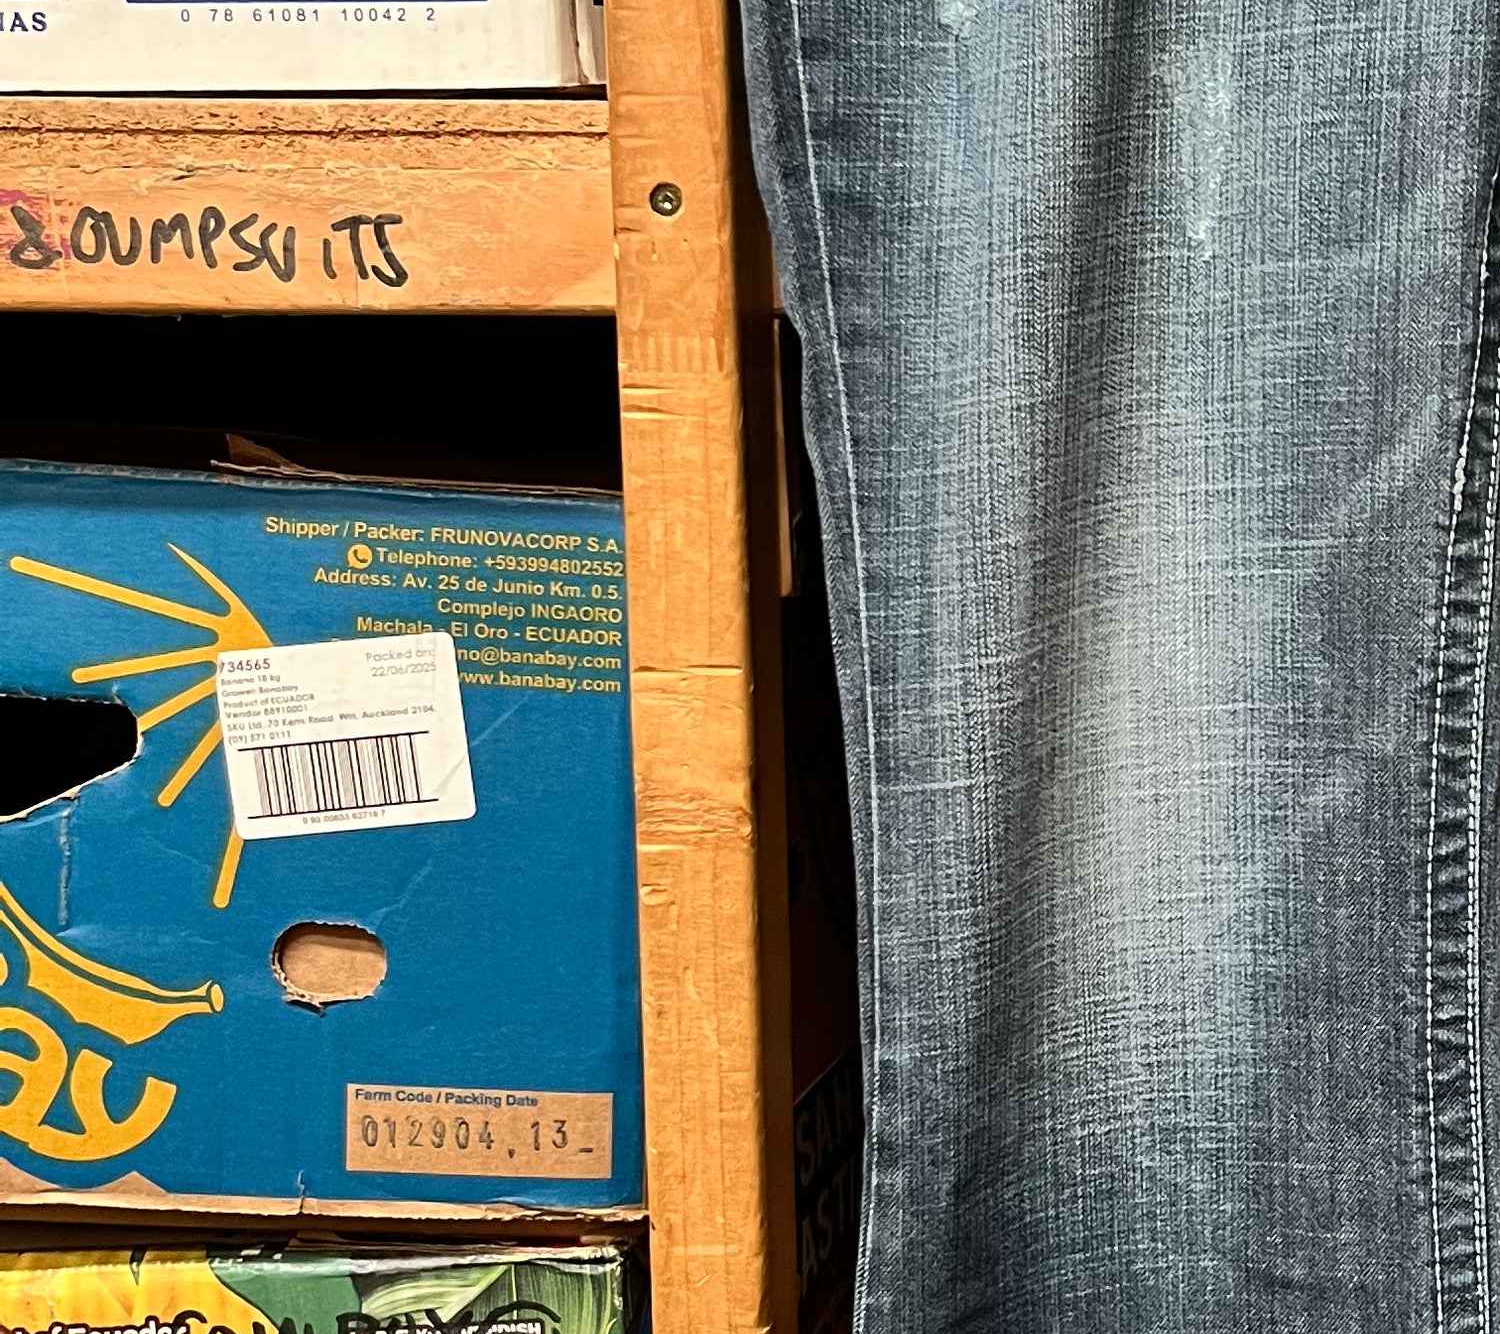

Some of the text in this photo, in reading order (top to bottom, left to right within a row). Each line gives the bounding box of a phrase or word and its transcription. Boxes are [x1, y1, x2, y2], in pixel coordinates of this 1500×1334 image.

[209, 9, 406, 22] 78 61081 10042
[266, 517, 581, 550] Shipper Packer: FRUNOVACORP
[376, 548, 624, 577] Telephone: +593994802552
[314, 568, 544, 596] Address: Av. 25 de Junio
[437, 598, 622, 624] Complejo INGAORO
[474, 623, 622, 647] Oro ECUADOR
[366, 649, 412, 663] Packed
[355, 1088, 538, 1108] Farm Code Packing Date
